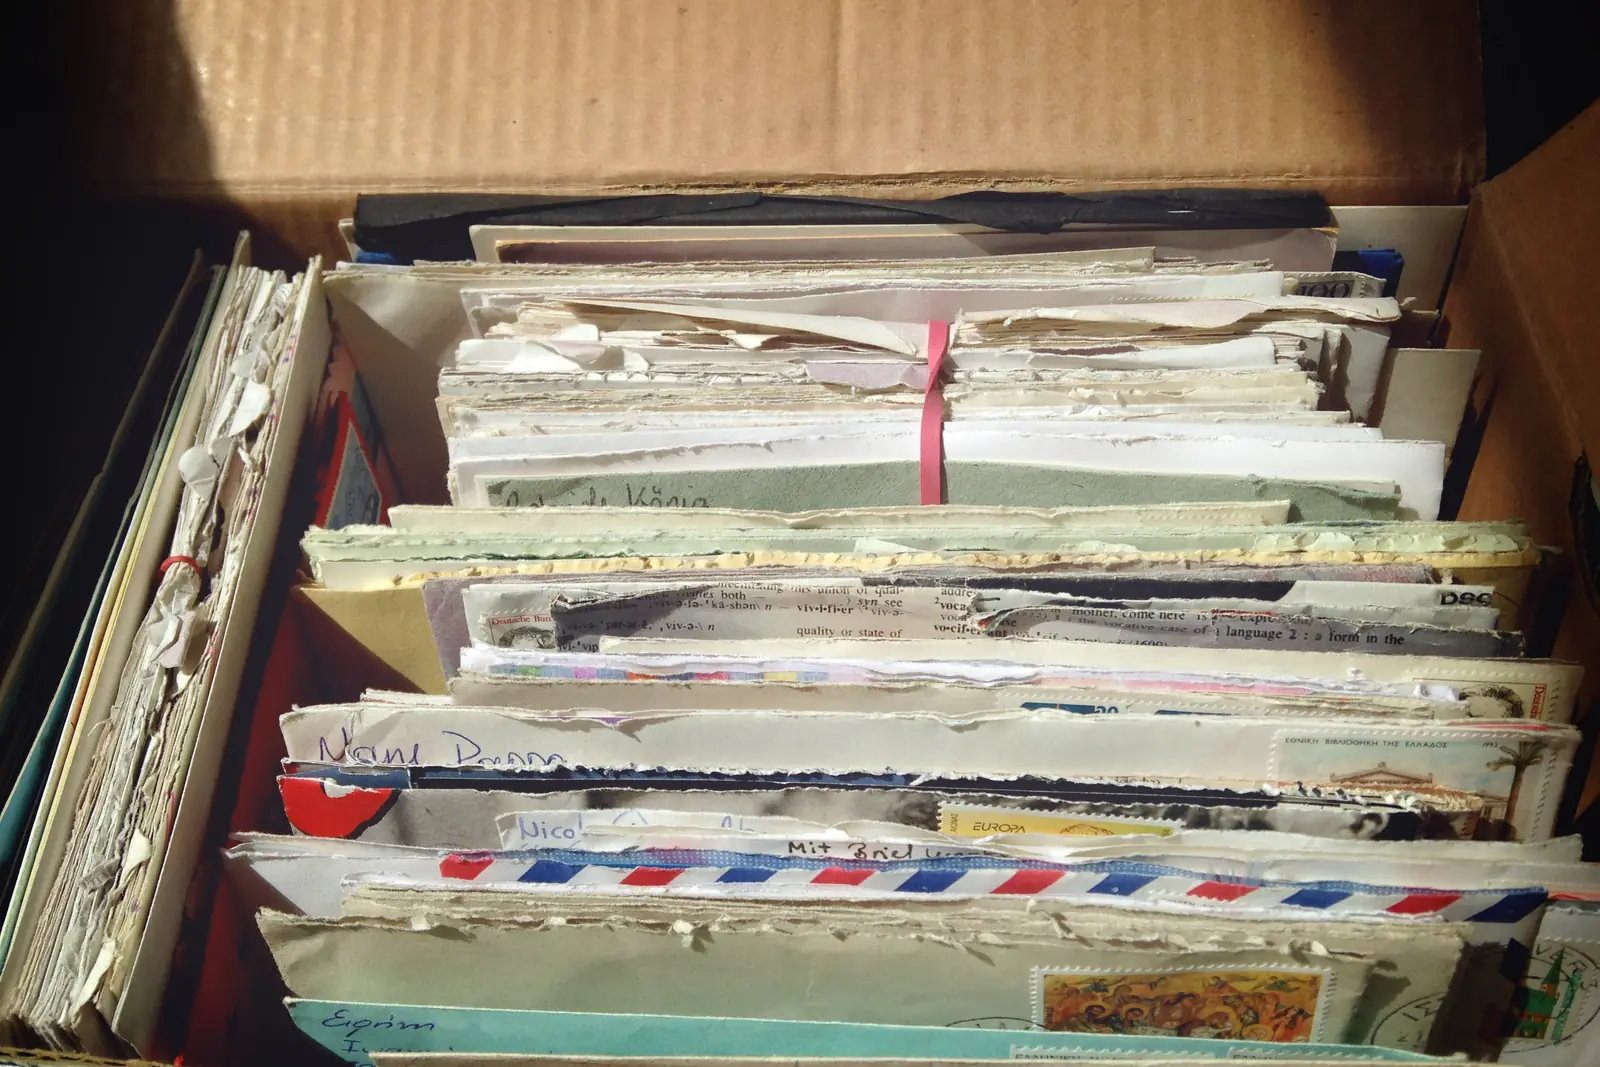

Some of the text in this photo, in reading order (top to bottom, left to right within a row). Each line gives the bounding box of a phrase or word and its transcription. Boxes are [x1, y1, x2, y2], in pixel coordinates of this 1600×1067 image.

[721, 590, 746, 600] both
[884, 599, 903, 608] see
[491, 615, 531, 626] Deutsche
[796, 626, 903, 638] quality or state of
[1160, 625, 1188, 633] case
[1192, 625, 1208, 635] of
[1225, 625, 1284, 642] language
[1288, 628, 1298, 640] 2
[1328, 631, 1359, 643] form
[1366, 634, 1378, 644] in
[1384, 635, 1405, 646] the
[1325, 738, 1379, 747] ΒΙΒΛΙΟΘΗΚΗ
[1382, 740, 1400, 748] ΤΗΣ
[1404, 740, 1448, 749] ΕΛΛΑΔΟΣ
[972, 821, 1026, 834] EUROPA
[788, 840, 832, 855] Mit
